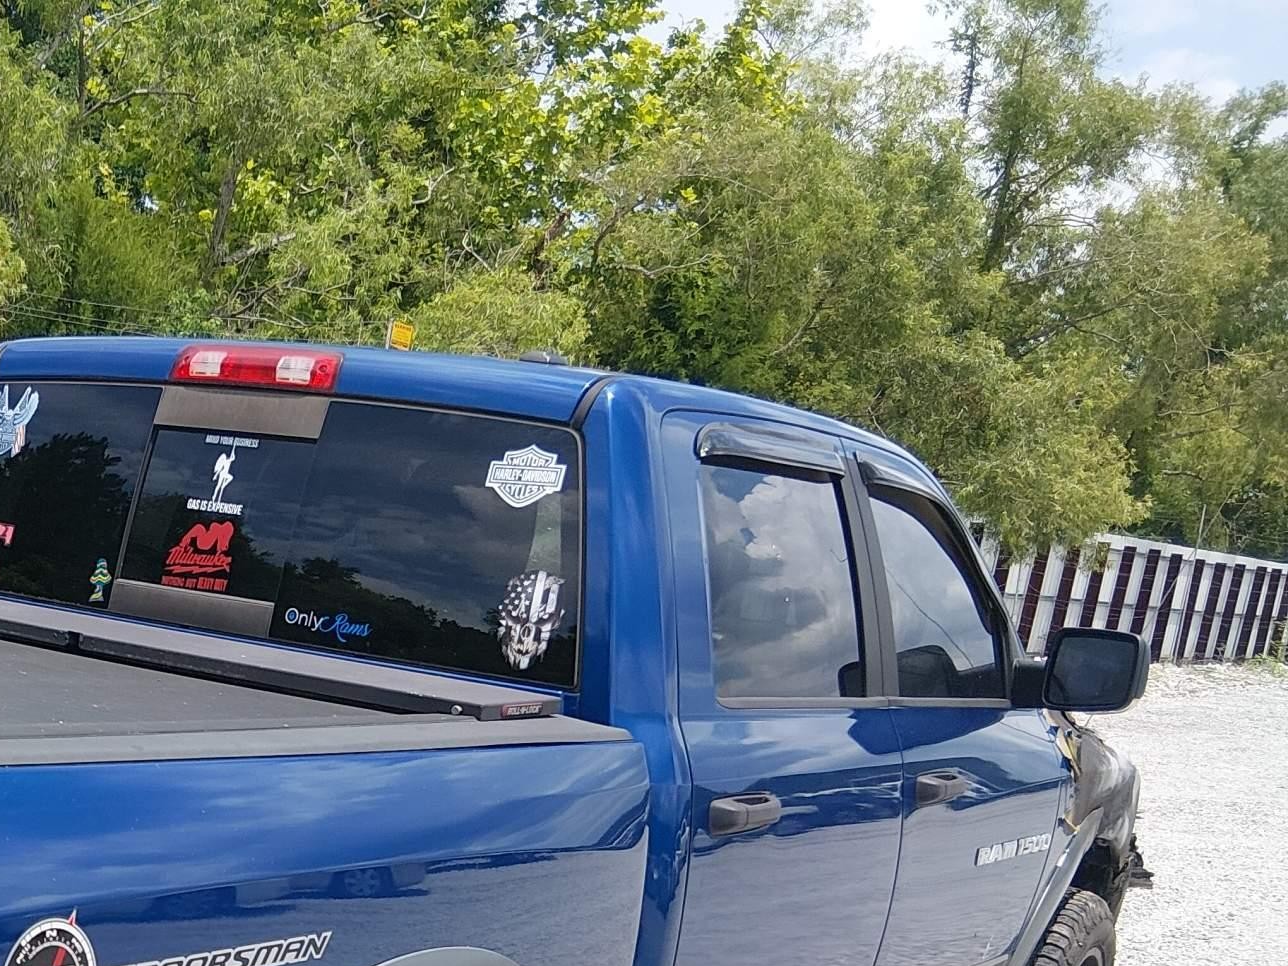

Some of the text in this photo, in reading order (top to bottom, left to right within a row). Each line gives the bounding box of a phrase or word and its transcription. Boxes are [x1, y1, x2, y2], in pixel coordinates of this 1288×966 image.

[511, 453, 548, 468] MOTOR
[493, 467, 558, 484] HARLEY-DAVIDSON
[187, 498, 243, 516] GAS IS EXPENSIVE
[975, 833, 1052, 867] RAM 1500
